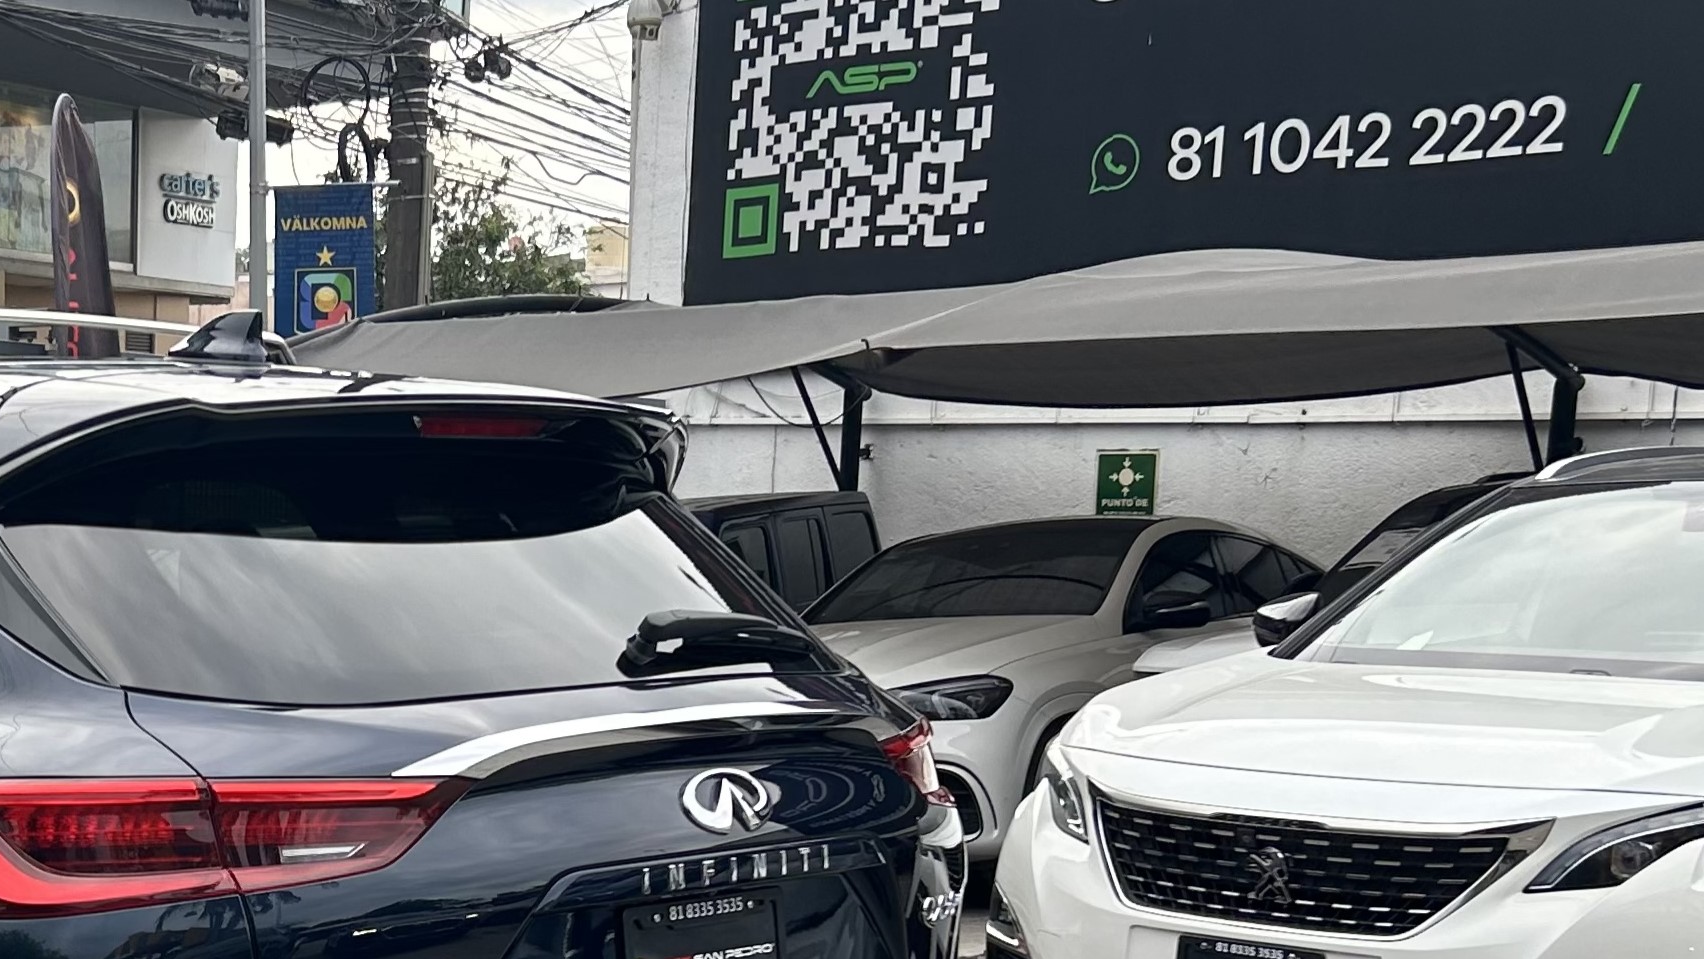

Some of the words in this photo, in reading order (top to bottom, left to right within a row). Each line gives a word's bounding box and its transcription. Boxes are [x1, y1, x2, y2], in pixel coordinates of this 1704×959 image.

[806, 61, 917, 98] ASP
[1167, 126, 1226, 181] 81
[1244, 112, 1392, 175] 1042
[1408, 96, 1567, 166] 2222
[160, 173, 220, 197] carter's
[280, 215, 368, 231] VÄLKOMNA
[1101, 498, 1133, 507] PUNTO
[1135, 498, 1148, 507] DE
[642, 845, 830, 895] INFINITI
[669, 905, 684, 921] 81
[686, 901, 714, 919] 8335
[716, 897, 744, 914] 3535
[725, 943, 775, 959] PEDRO
[1215, 942, 1229, 953] 81
